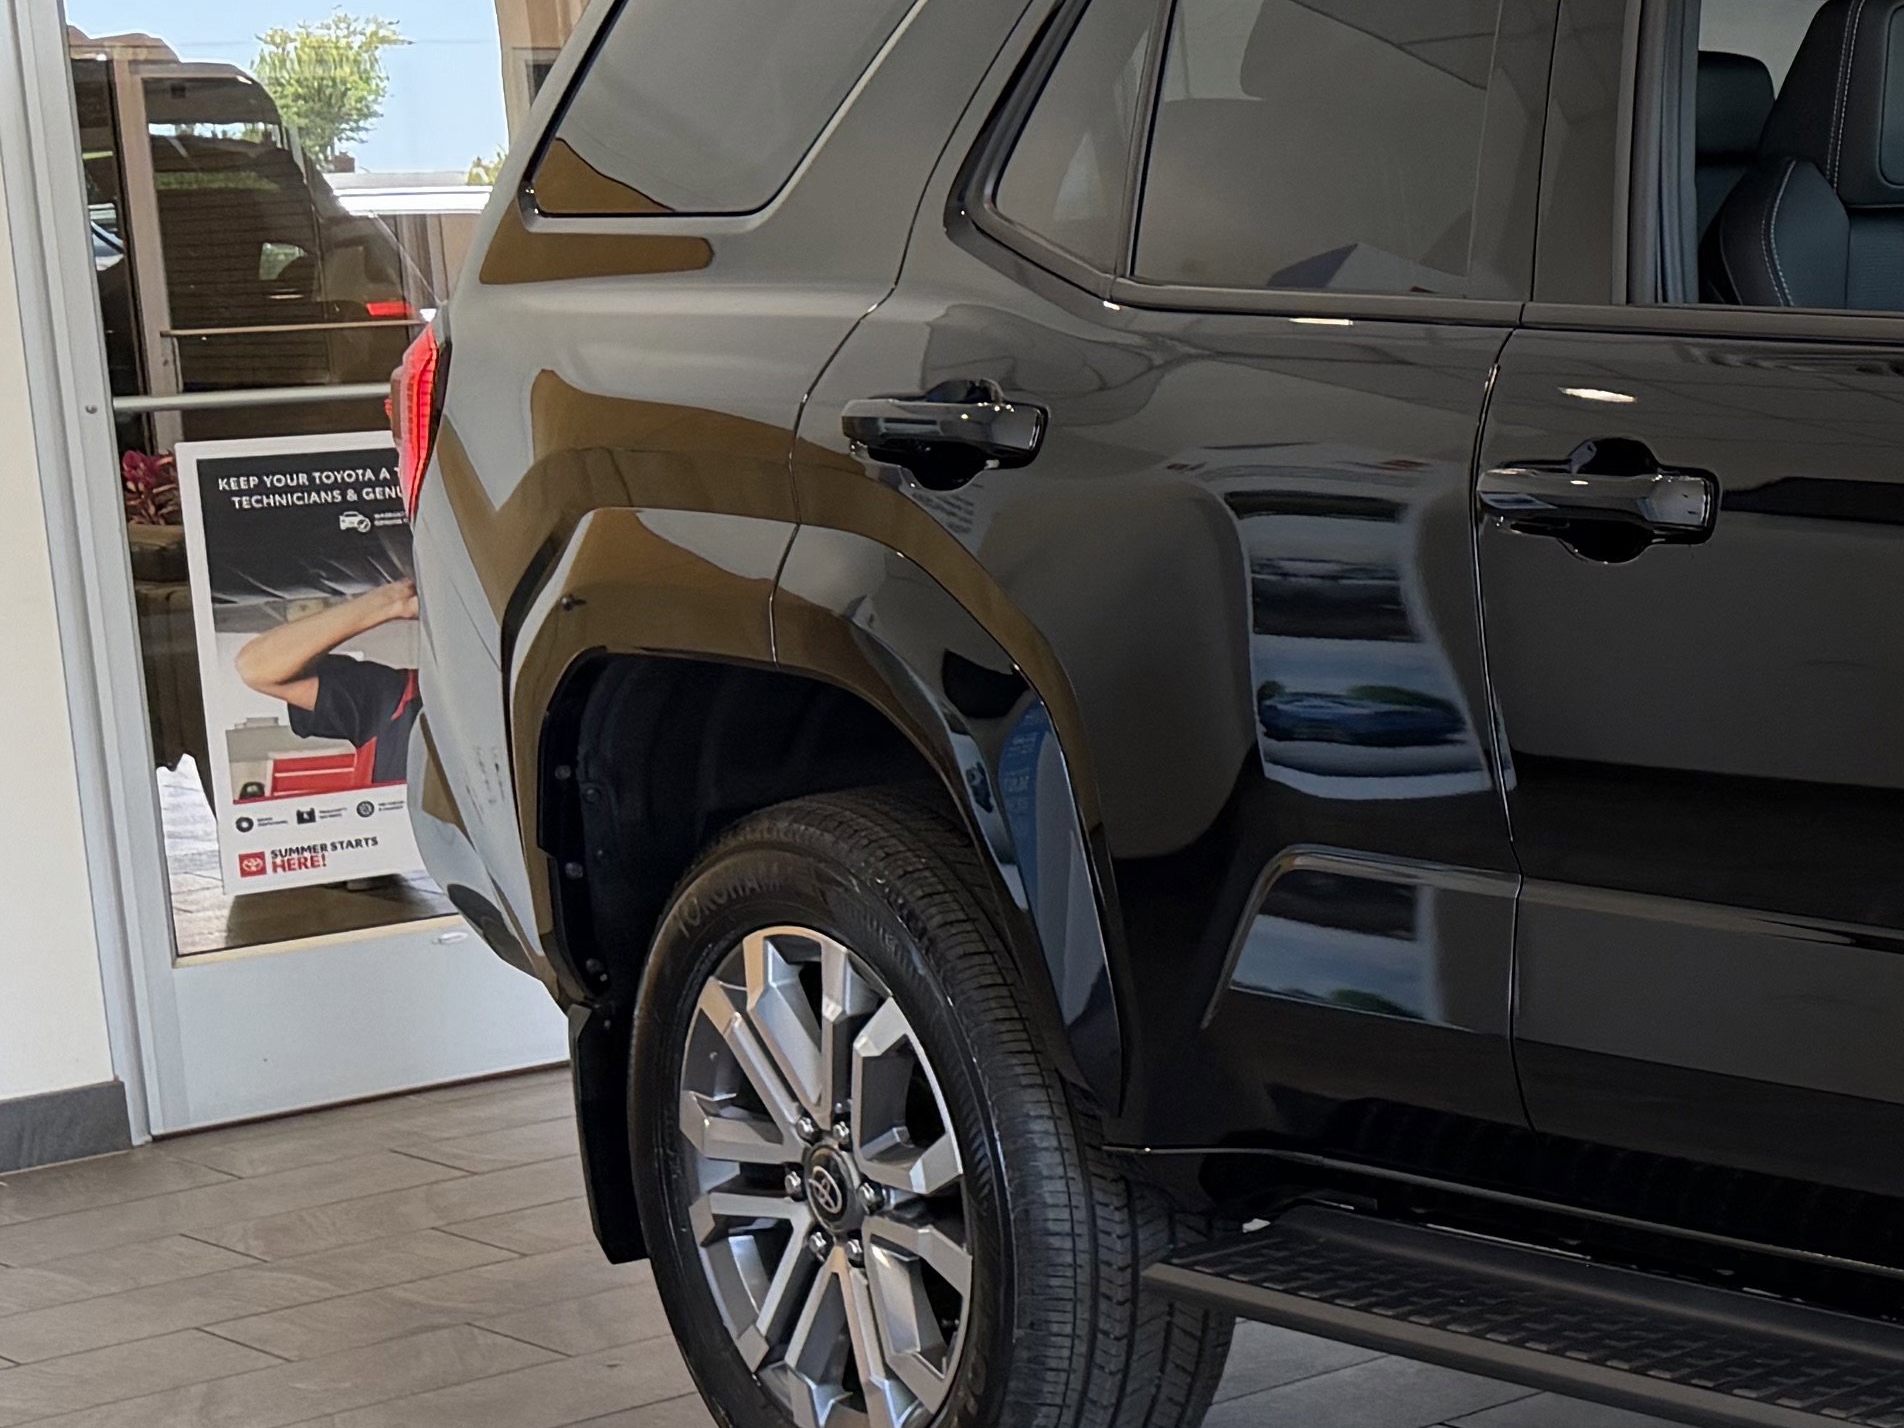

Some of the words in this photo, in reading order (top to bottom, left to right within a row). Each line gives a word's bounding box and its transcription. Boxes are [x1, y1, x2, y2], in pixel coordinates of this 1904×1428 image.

[218, 476, 259, 491] KEEP
[263, 473, 309, 489] YOUR
[312, 468, 376, 485] TOYOTA
[379, 467, 391, 480] A
[231, 489, 342, 510] TECHNICIANS
[346, 489, 358, 502] &
[270, 843, 329, 859] SUMMER
[331, 836, 379, 851] STARTS
[271, 853, 328, 874] HERE!
